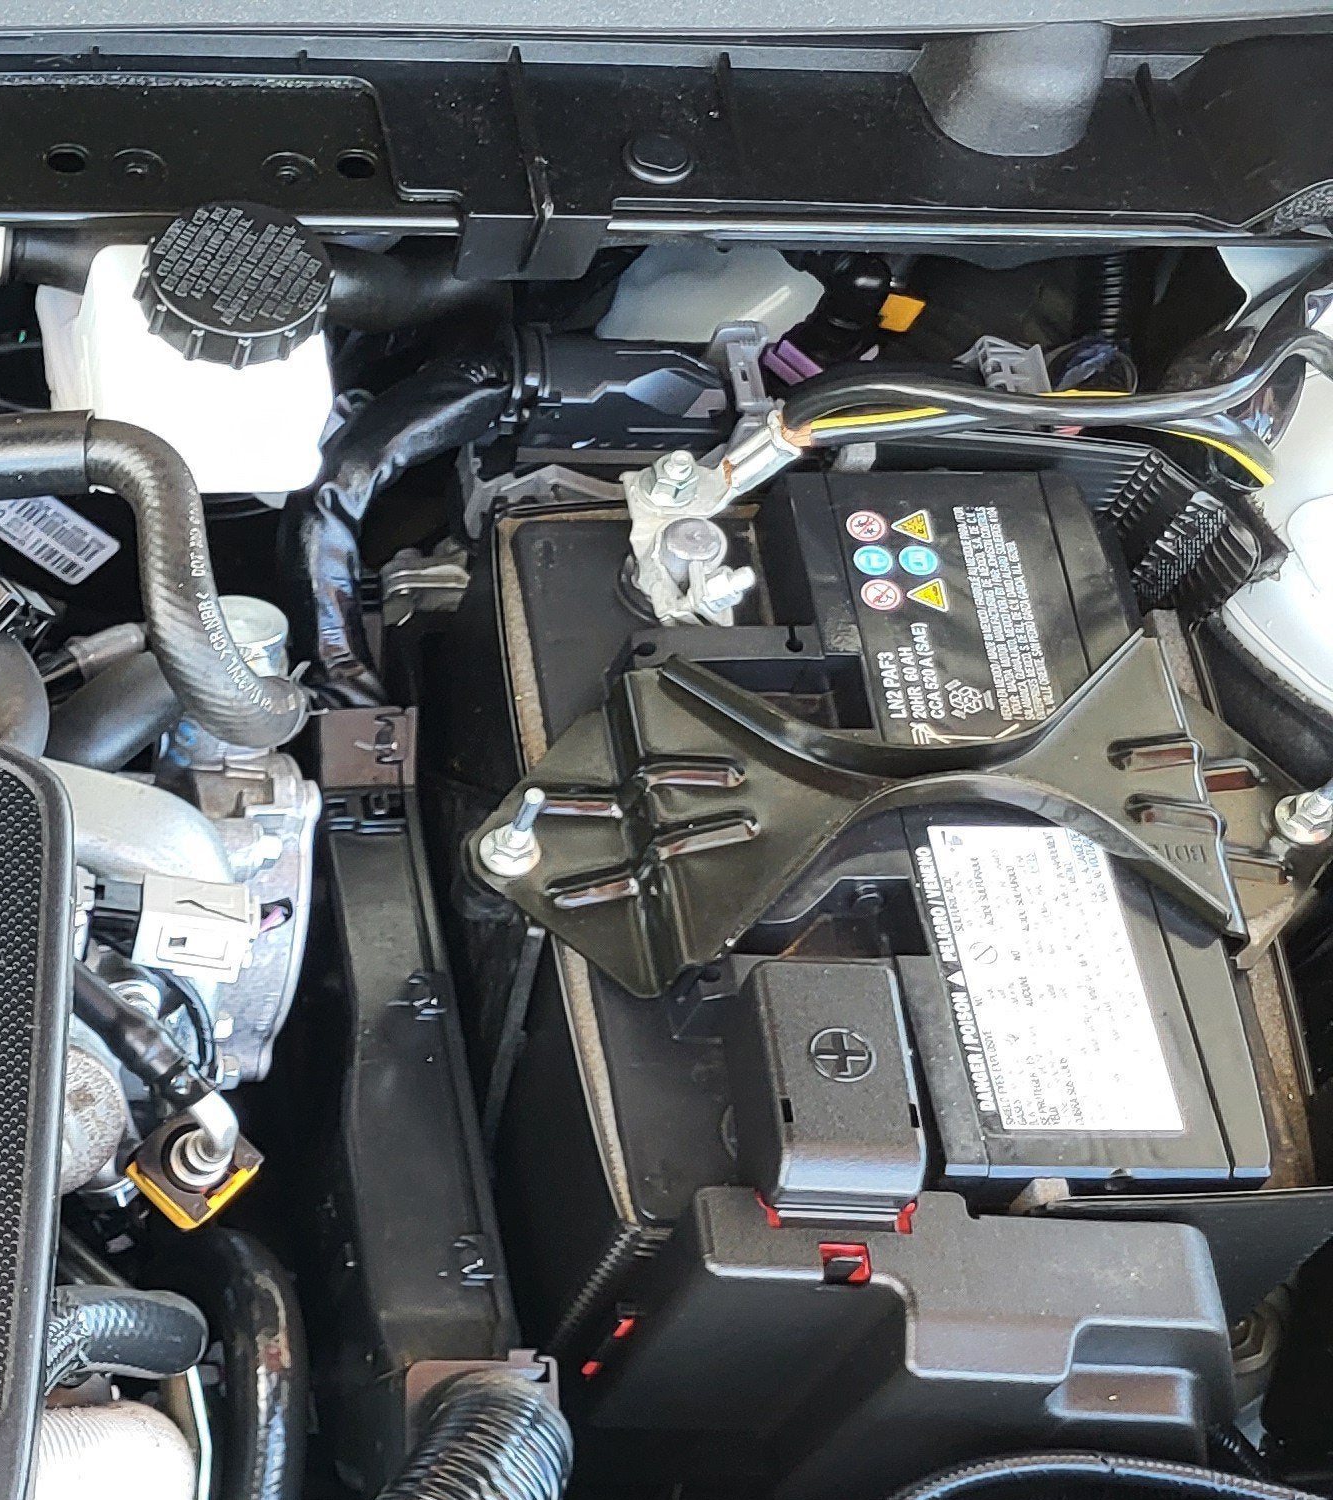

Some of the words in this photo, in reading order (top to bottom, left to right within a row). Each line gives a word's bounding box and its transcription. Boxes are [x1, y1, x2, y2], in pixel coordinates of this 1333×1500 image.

[909, 622, 934, 655] (SAE)
[877, 651, 900, 687] PAF3
[896, 646, 915, 665] AH
[917, 656, 934, 667] A
[901, 666, 919, 681] 60
[920, 668, 939, 689] 520
[885, 689, 907, 719] LN2
[906, 685, 927, 719] 20HR
[925, 690, 945, 719] CCA
